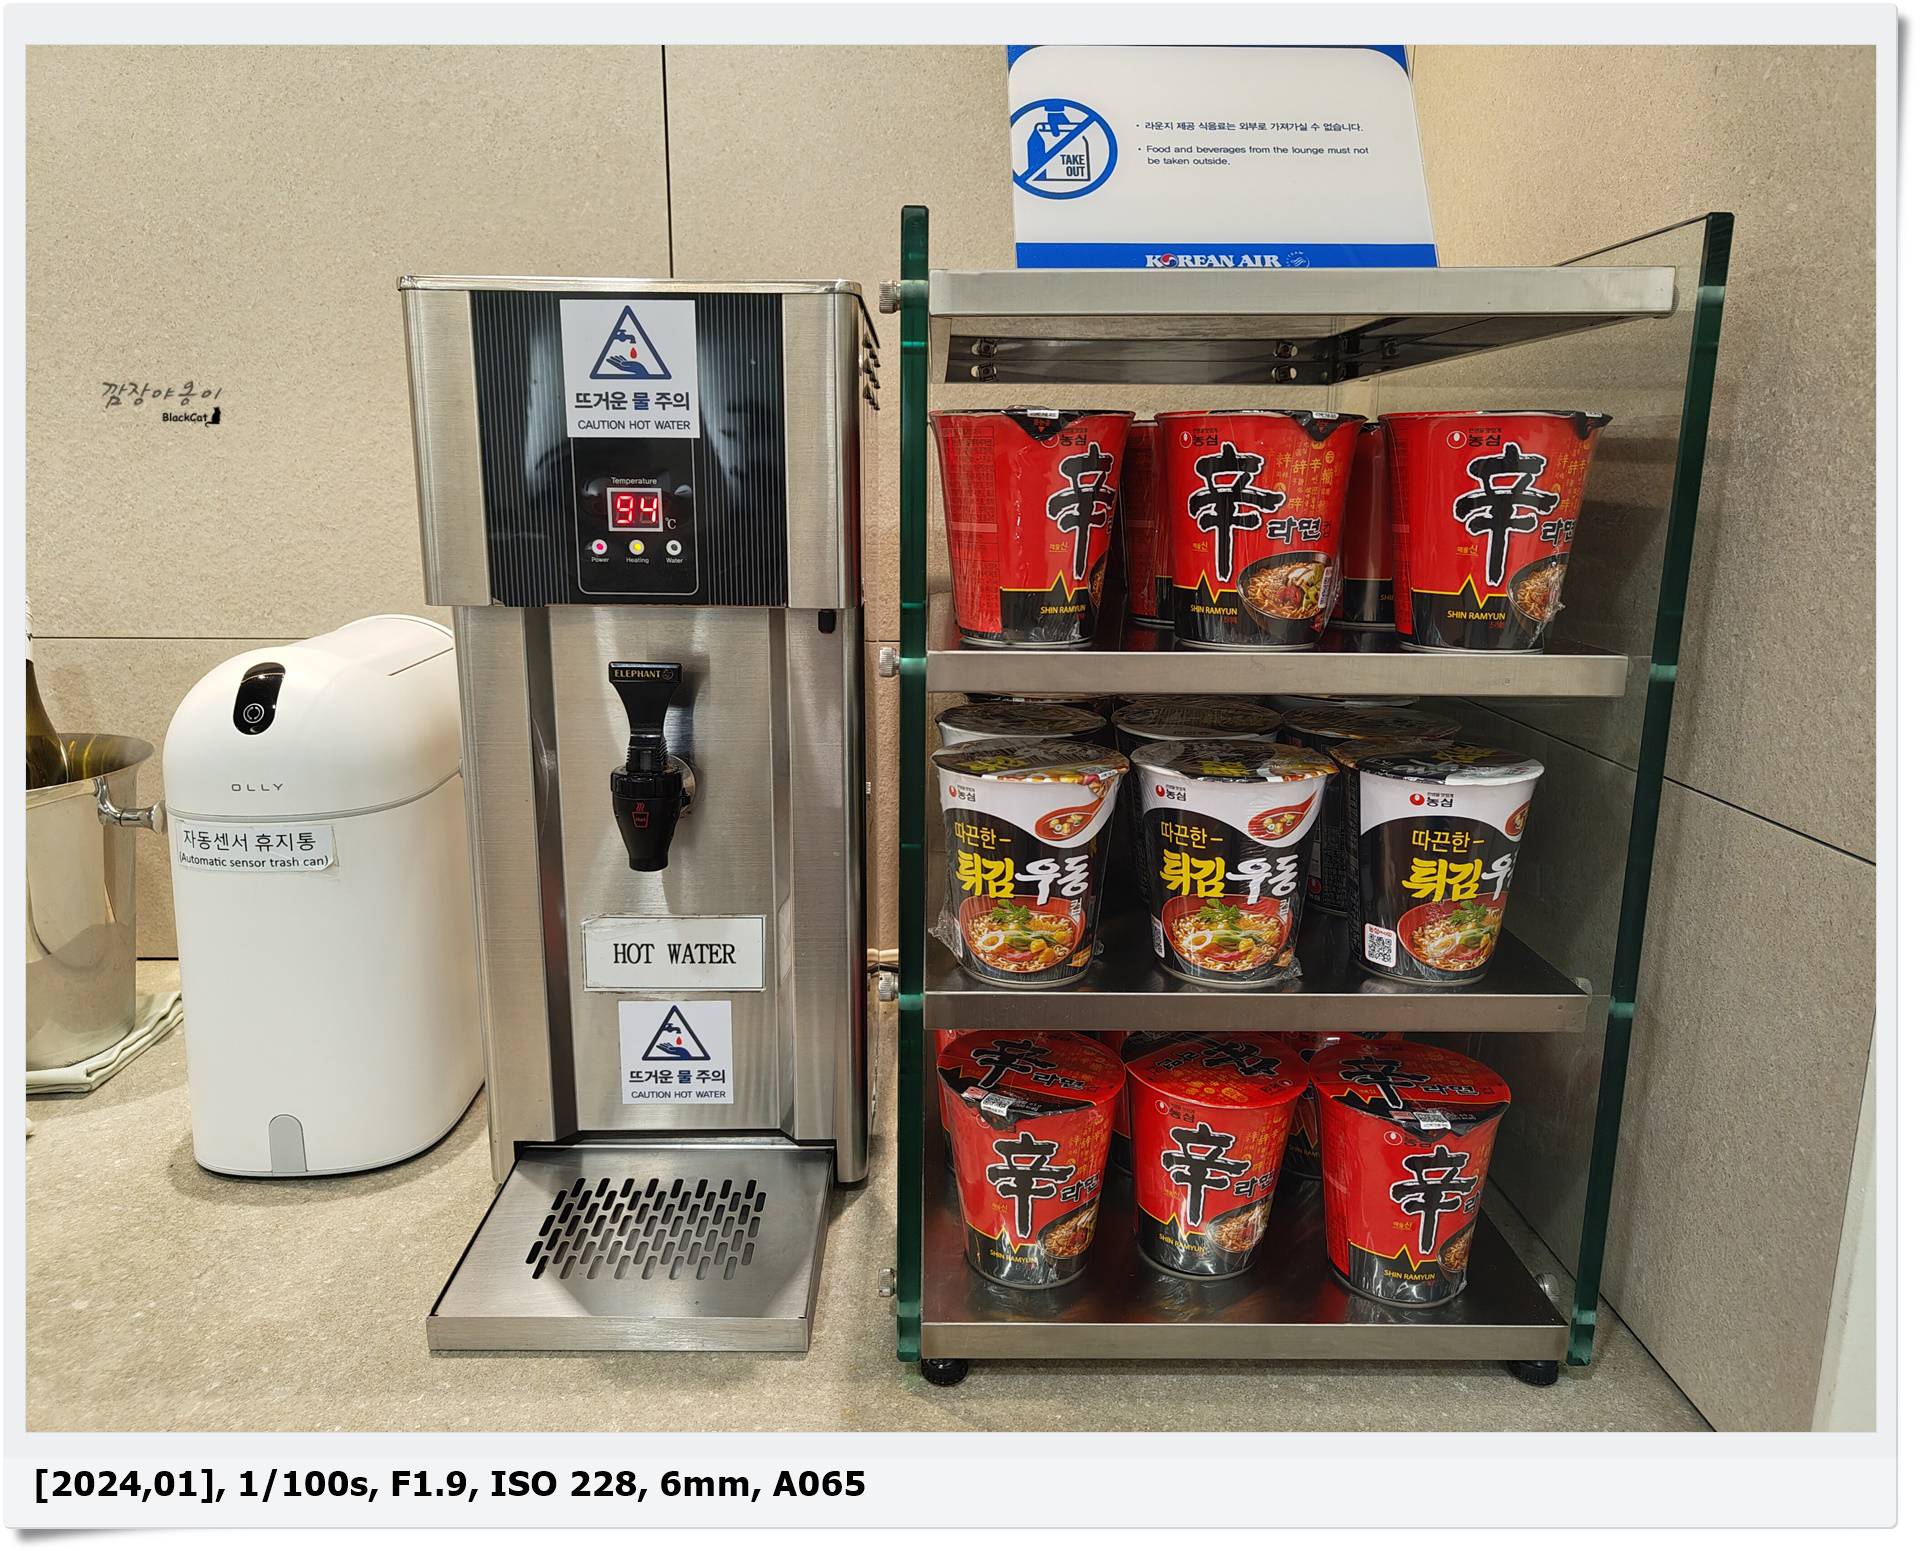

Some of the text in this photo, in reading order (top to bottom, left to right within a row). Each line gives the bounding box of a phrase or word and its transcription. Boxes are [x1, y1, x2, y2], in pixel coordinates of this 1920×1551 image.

[1145, 122, 1364, 132] 라운지 제공 식음료는 외부로 가져가실 수 없습니다.
[1146, 145, 1171, 153] Food
[1196, 146, 1246, 154] beverages
[1249, 146, 1270, 154] from
[1273, 146, 1288, 154] the
[1292, 146, 1324, 155] lounge
[1060, 154, 1085, 165] TAKE
[1147, 157, 1231, 166] be taken outside.
[1066, 166, 1085, 177] OUT
[1238, 254, 1282, 268] AIR
[574, 391, 690, 411] 뜨거운 물 주의
[578, 419, 691, 431] CAUTION HOT WATER
[1061, 433, 1088, 446] 농심
[1193, 434, 1218, 446] 농심
[1468, 434, 1501, 447] 농심
[611, 477, 657, 485] Temperature
[615, 494, 658, 524] 94
[1046, 441, 1116, 580] 辛
[1188, 441, 1286, 582] 辛
[1453, 442, 1560, 587] 辛
[1266, 516, 1321, 544] 라면
[591, 556, 609, 564] Power
[626, 556, 649, 566] Heating
[665, 556, 683, 564] Water
[1040, 604, 1086, 614] SHIN RAMYUN
[1191, 605, 1238, 615] SHIN RAMYUN
[1447, 610, 1506, 620] SHIN RAMYUN
[614, 670, 661, 679] ELEPHANT
[231, 783, 283, 792] OLLY
[957, 789, 976, 802] 농심
[1166, 789, 1186, 801] 농심
[1426, 797, 1453, 807] 농심
[183, 829, 316, 852] 자동센서 휴지통
[179, 852, 329, 868] (Automatic sensor trash can)
[613, 943, 737, 965] HOT WATER
[629, 1069, 725, 1085] 뜨거운 물 주의
[1031, 1072, 1086, 1091] 라면
[1339, 1055, 1430, 1109] 辛
[631, 1091, 726, 1099] CAUTION HOT WATER
[1420, 1084, 1480, 1096] 라면
[1170, 1108, 1195, 1123] 농심
[1161, 1121, 1251, 1227] 辛
[986, 1132, 1076, 1239] 辛
[1060, 1170, 1100, 1202] 라면
[1233, 1168, 1275, 1198] 라면
[1389, 1144, 1478, 1255] 辛
[1159, 1233, 1206, 1252] SHIN RAMYUN
[990, 1249, 1005, 1259] SHIN
[1384, 1270, 1435, 1281] SHIN RAMYUN
